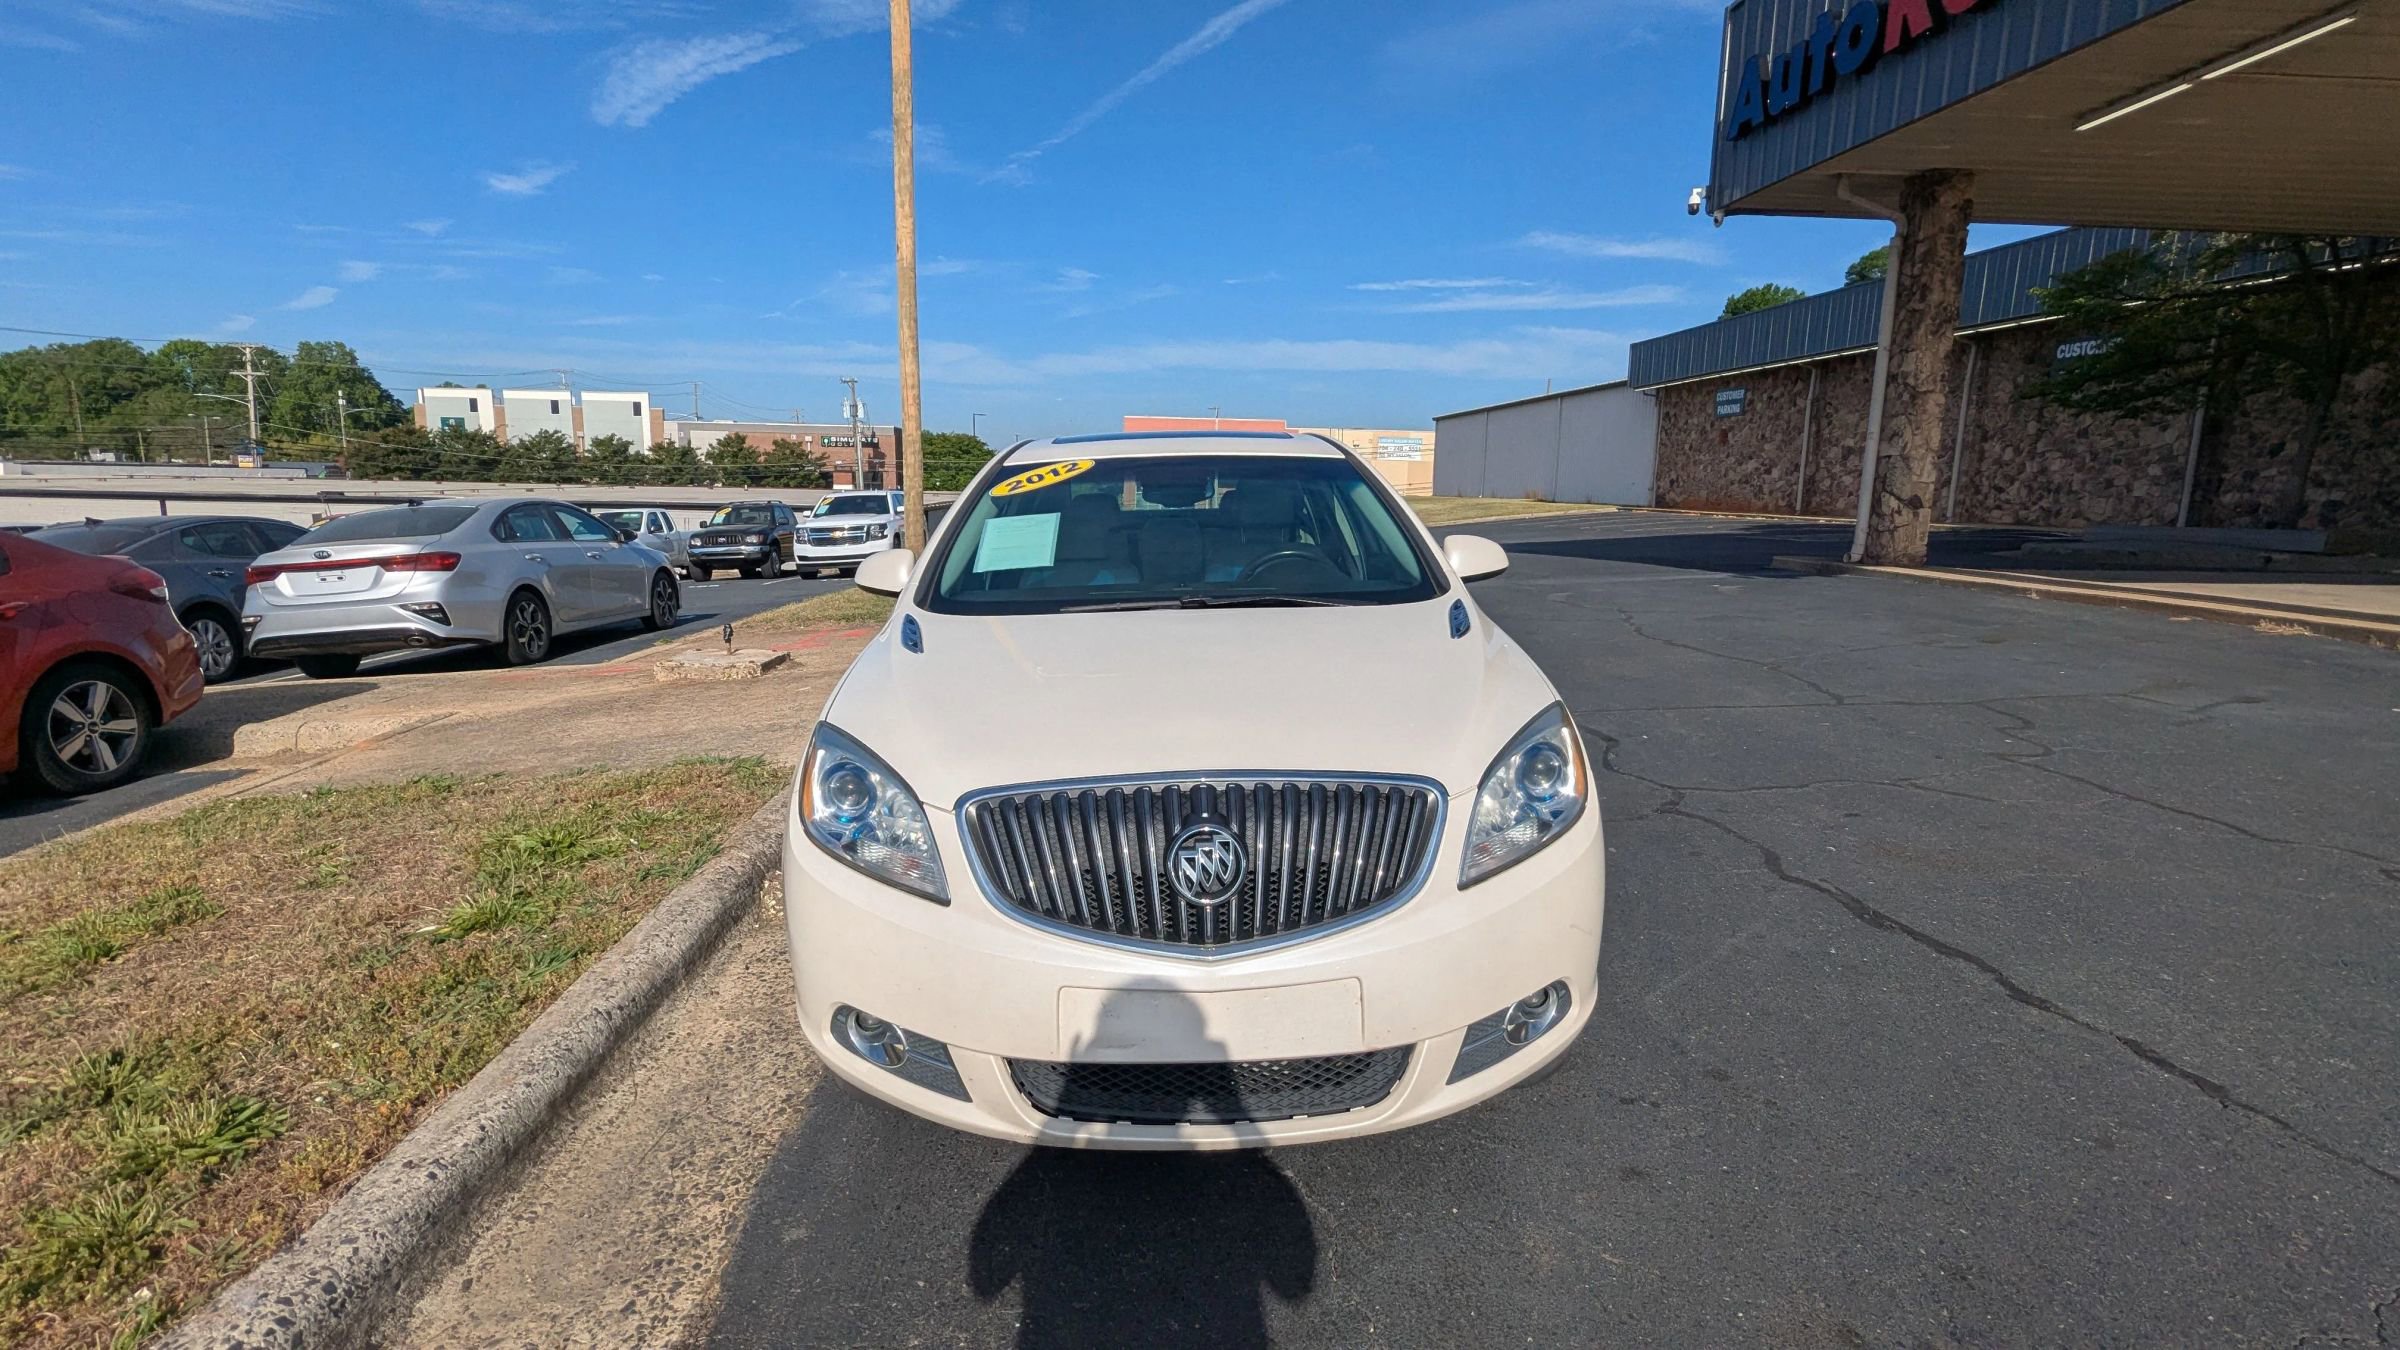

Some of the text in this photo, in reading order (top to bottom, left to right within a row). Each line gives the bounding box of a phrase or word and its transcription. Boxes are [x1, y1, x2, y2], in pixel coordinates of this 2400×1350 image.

[1727, 0, 1987, 141] Auto
[1716, 389, 1745, 402] CUSTOMER
[1717, 403, 1741, 416] PARKING
[1005, 462, 1083, 493] 2012
